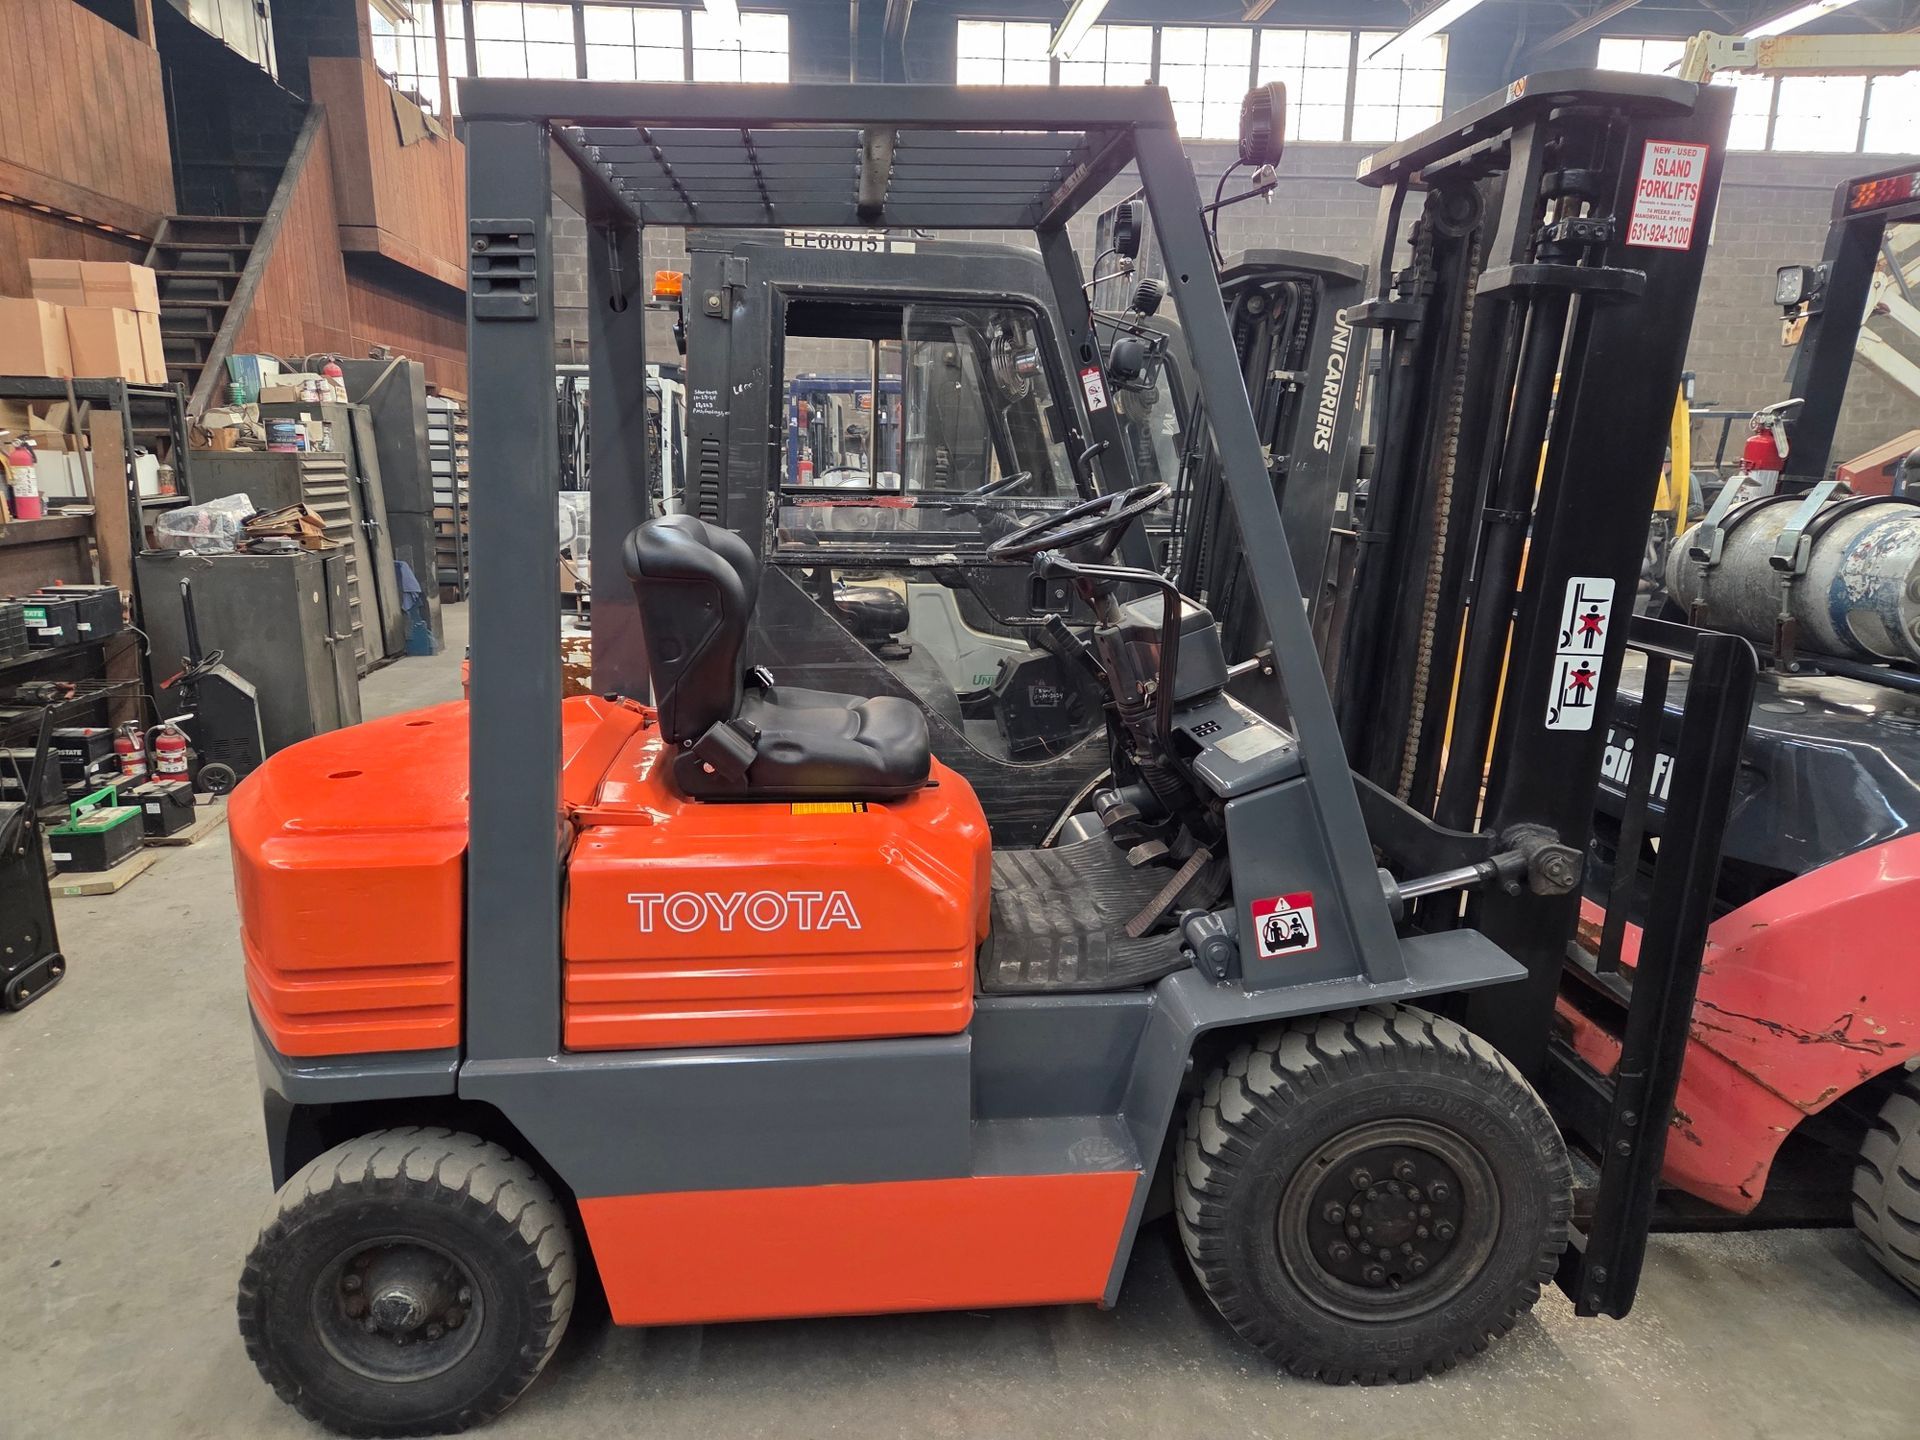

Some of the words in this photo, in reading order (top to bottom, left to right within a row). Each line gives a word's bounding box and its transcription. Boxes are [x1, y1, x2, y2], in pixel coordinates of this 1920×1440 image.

[1653, 145, 1671, 155] NEW
[1677, 148, 1697, 157] USED
[1652, 158, 1691, 178] ISLAND
[1638, 179, 1698, 202] FORKLIFTS
[790, 231, 878, 252] LE00015
[1631, 222, 1690, 244] 631-924-3100
[628, 890, 861, 932] TOYOTA
